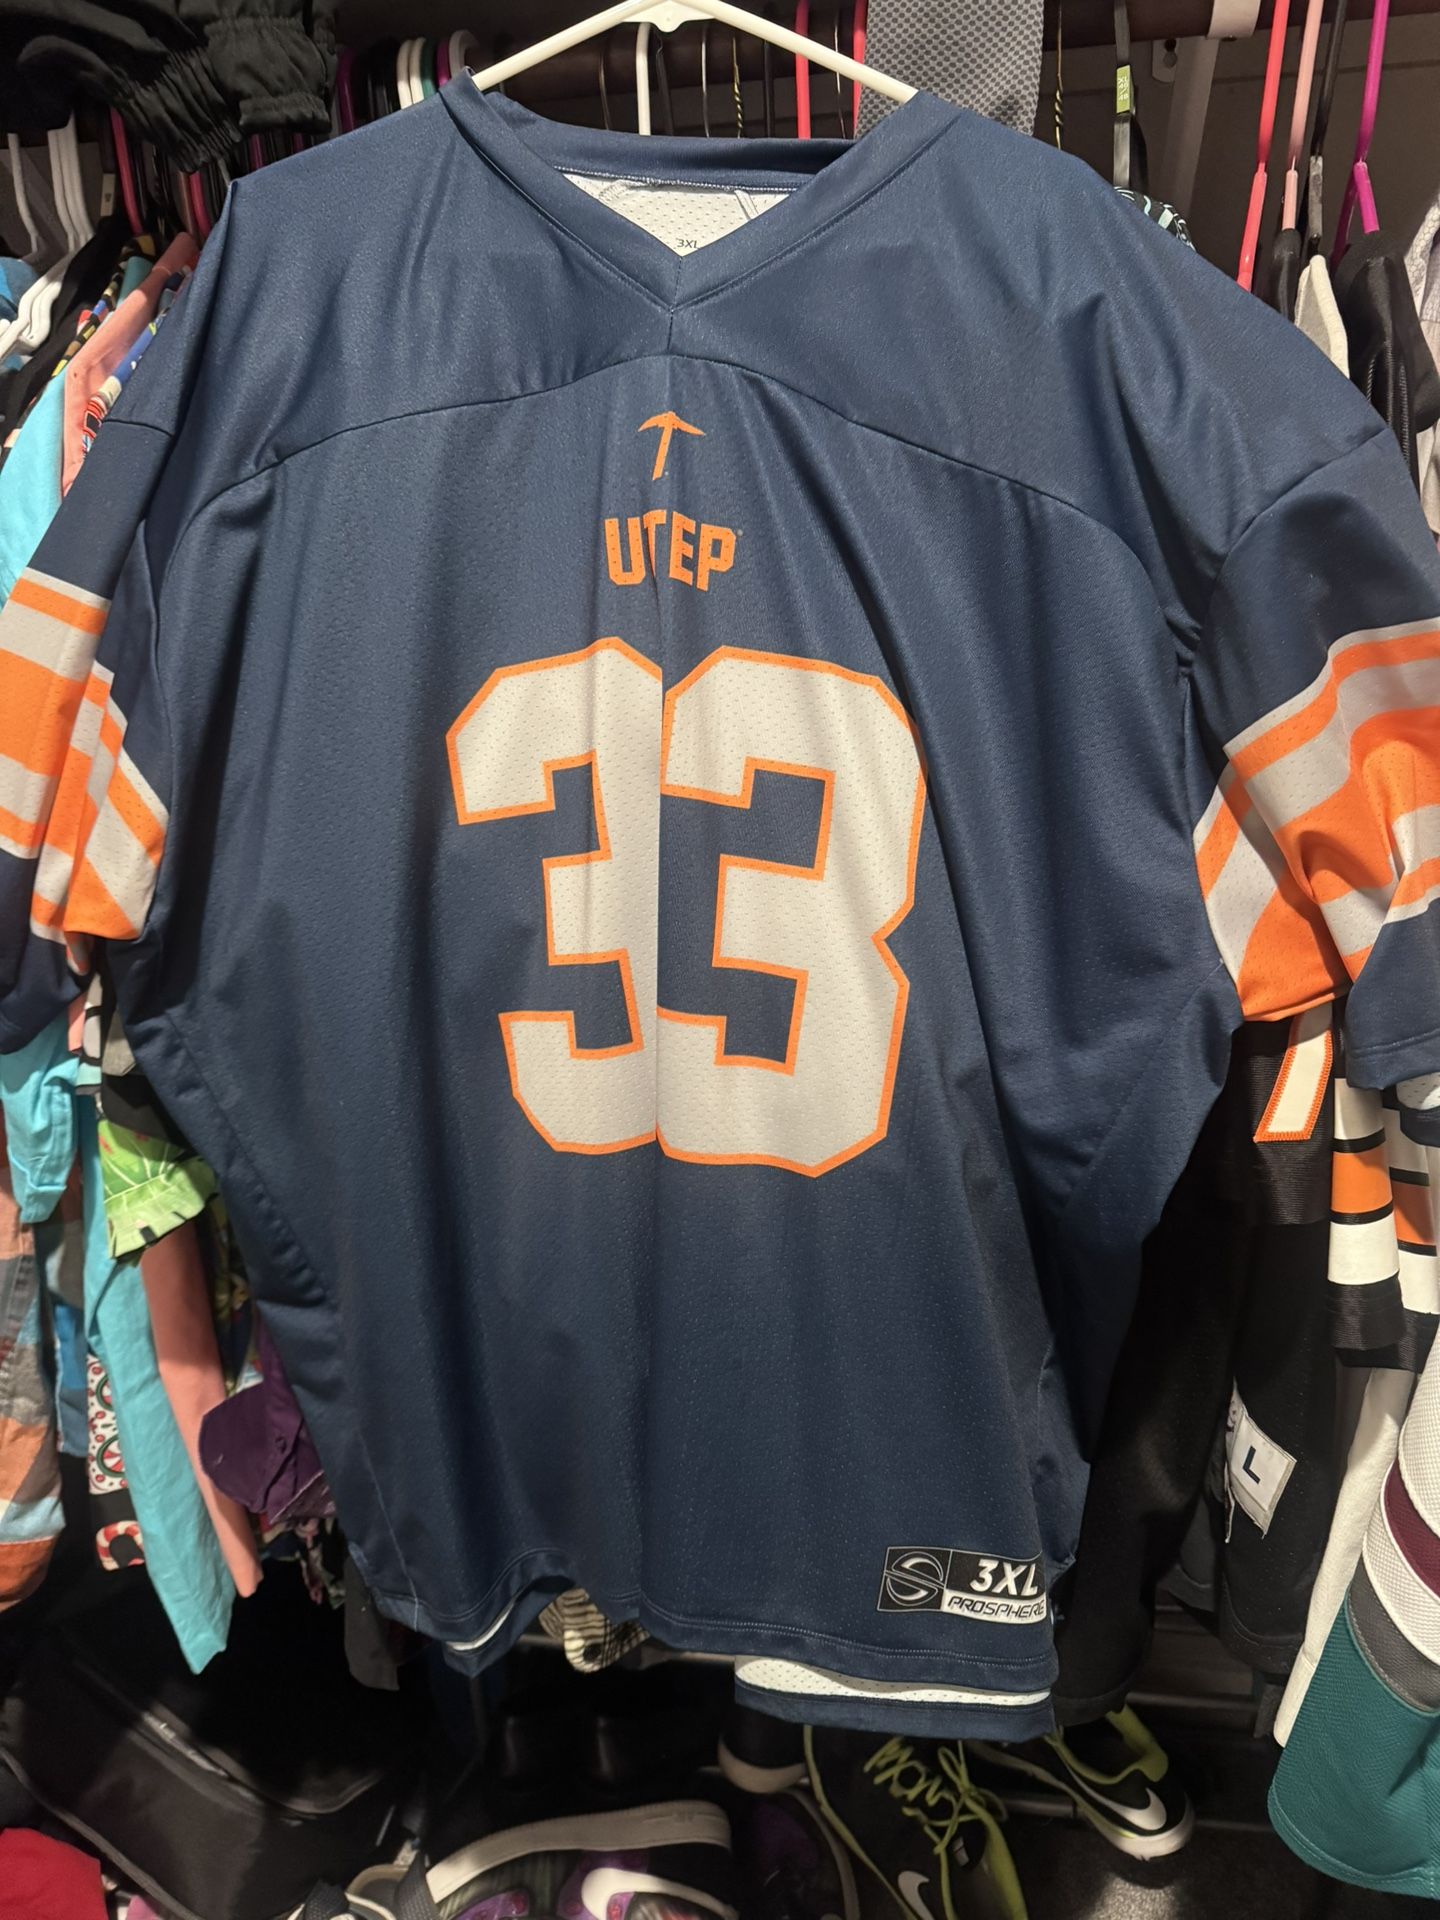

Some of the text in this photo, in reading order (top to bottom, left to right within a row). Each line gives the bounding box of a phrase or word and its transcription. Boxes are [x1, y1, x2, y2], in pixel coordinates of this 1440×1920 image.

[675, 237, 700, 249] 3XL
[604, 509, 737, 592] UTEP
[446, 636, 928, 1178] 33
[1242, 1445, 1260, 1484] L
[970, 1559, 1038, 1596] 3XL
[948, 1596, 1045, 1618] PROSPHERE
